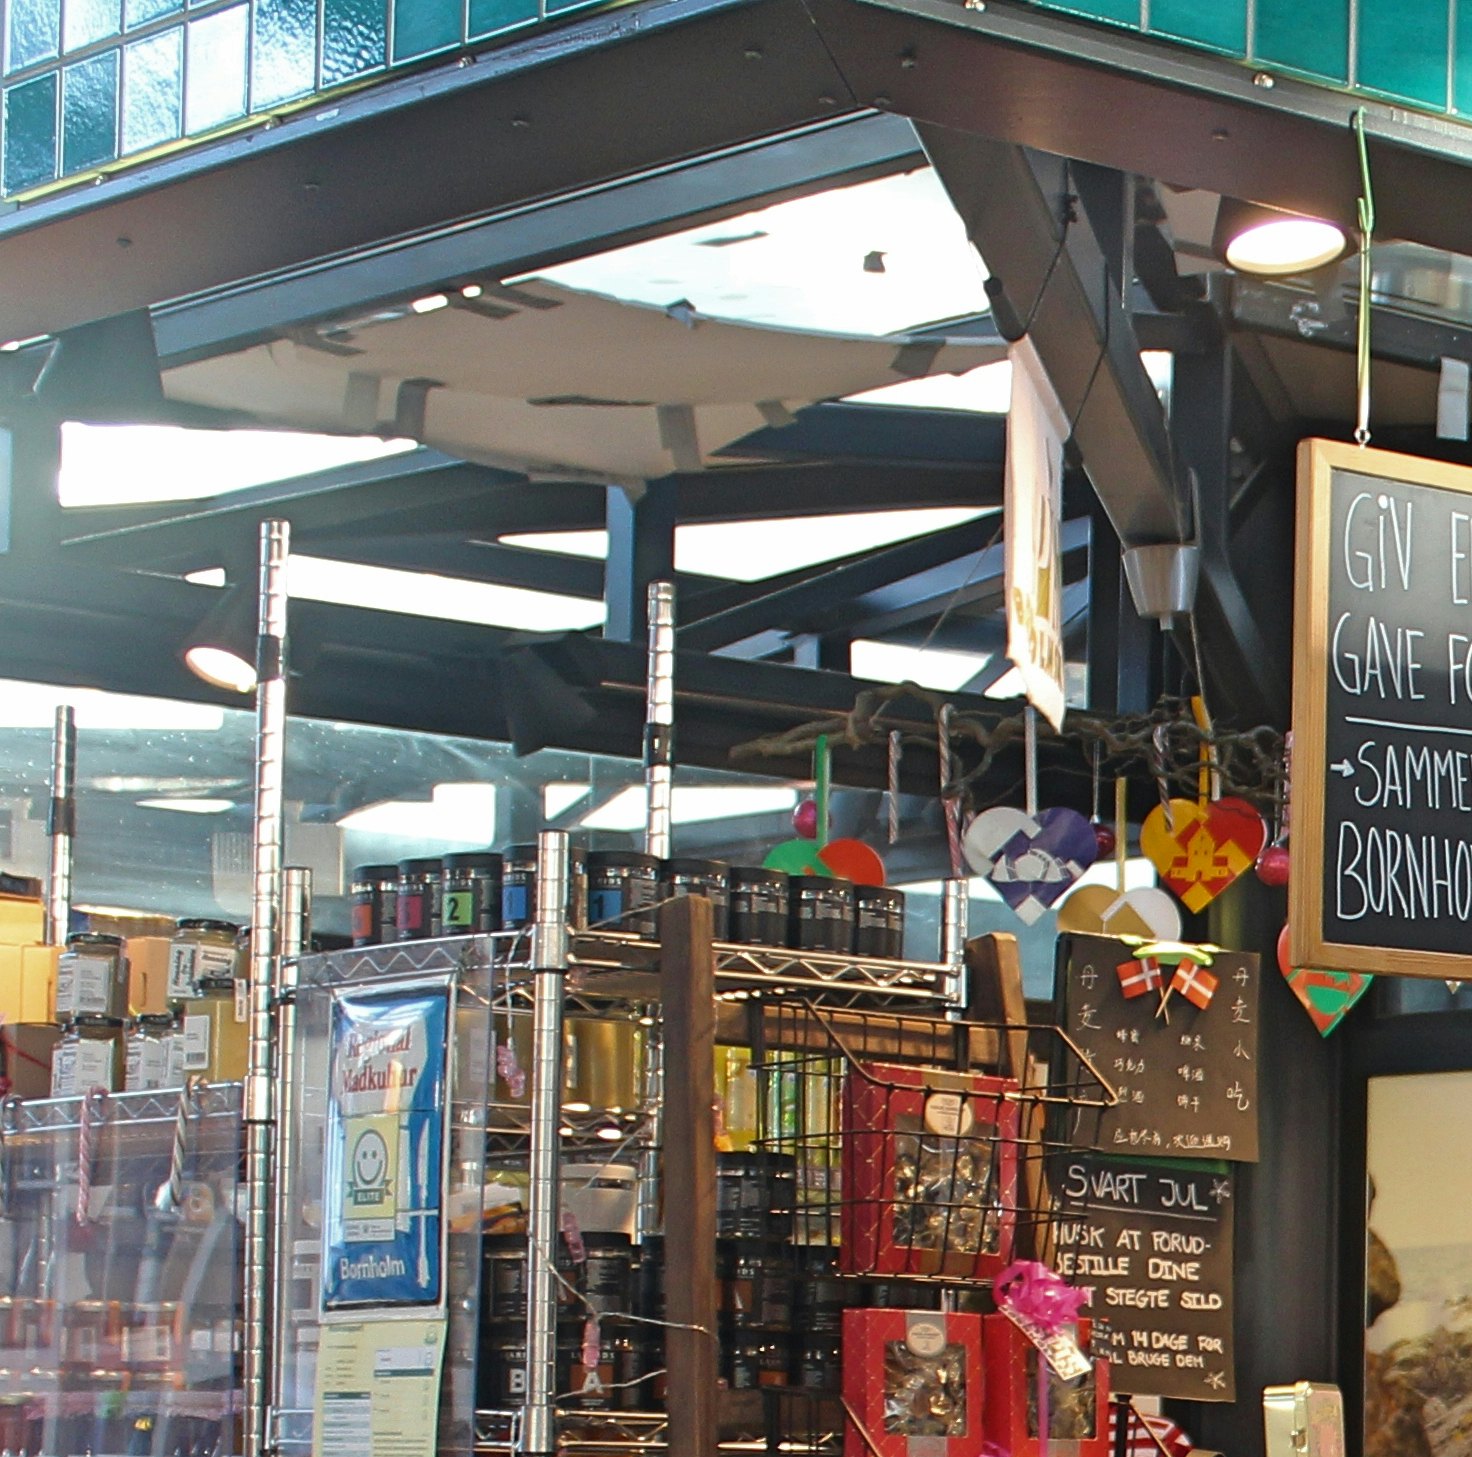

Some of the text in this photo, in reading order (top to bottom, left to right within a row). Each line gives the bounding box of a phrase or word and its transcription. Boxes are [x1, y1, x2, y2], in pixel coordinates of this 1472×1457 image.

[1331, 611, 1425, 700] GAVE
[1065, 1164, 1209, 1212] SVART JUL
[1116, 1229, 1142, 1251] AT
[339, 1254, 405, 1282] Bornholm
[1148, 1256, 1200, 1281] DINE
[1105, 1286, 1170, 1309] STEGTE
[1180, 1290, 1222, 1310] SILD
[1151, 1330, 1189, 1352] DAGE
[1127, 1352, 1170, 1369] BRUGE
